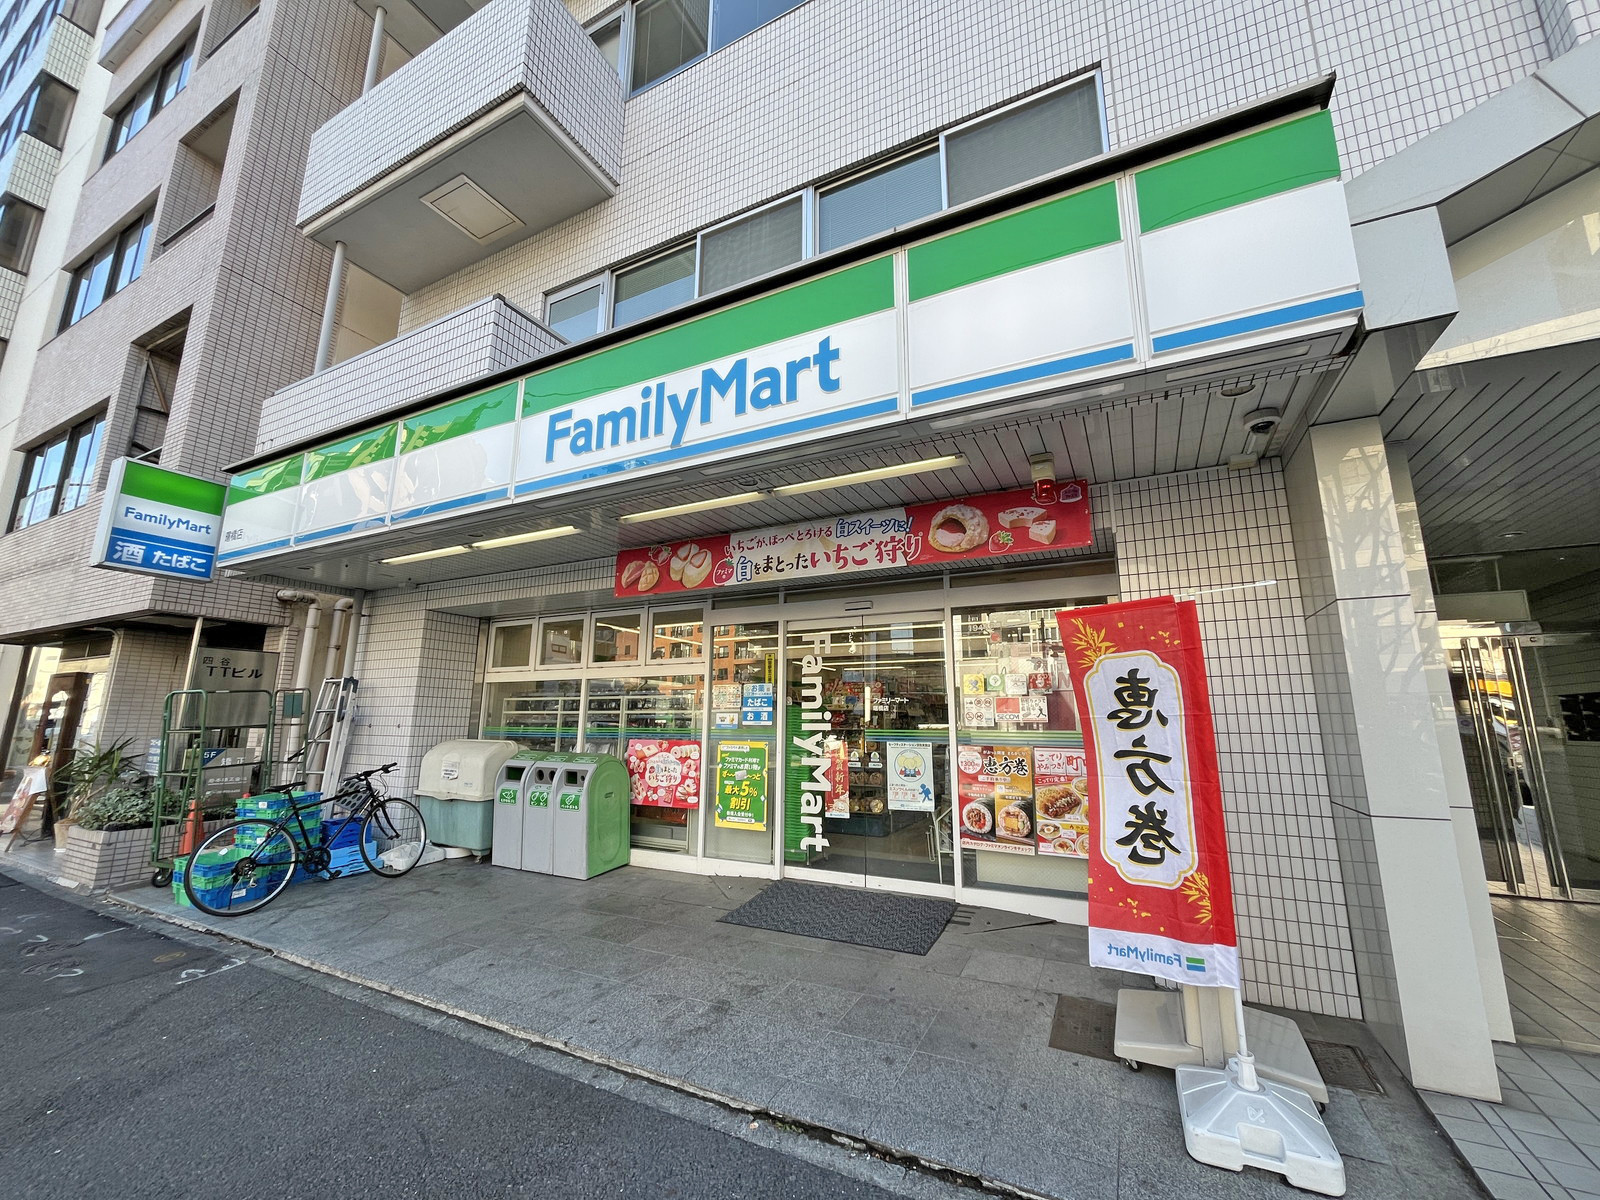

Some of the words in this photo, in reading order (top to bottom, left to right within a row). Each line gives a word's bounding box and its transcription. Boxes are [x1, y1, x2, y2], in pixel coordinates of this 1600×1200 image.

[546, 335, 841, 463] FamilyMart
[124, 506, 212, 535] FamilyMart
[112, 541, 147, 564] 酒
[152, 550, 207, 572] たばこ
[203, 656, 231, 666] 四谷
[207, 665, 263, 679] TTビル
[747, 698, 768, 706] たばこ
[793, 634, 832, 852] FamilyMart
[1037, 753, 1063, 762] こってり
[1066, 755, 1087, 771] 町
[983, 756, 1029, 776] 恵方巻
[1037, 762, 1065, 771] やみつき!
[725, 781, 758, 796] 最大5%
[730, 797, 751, 810] 割引
